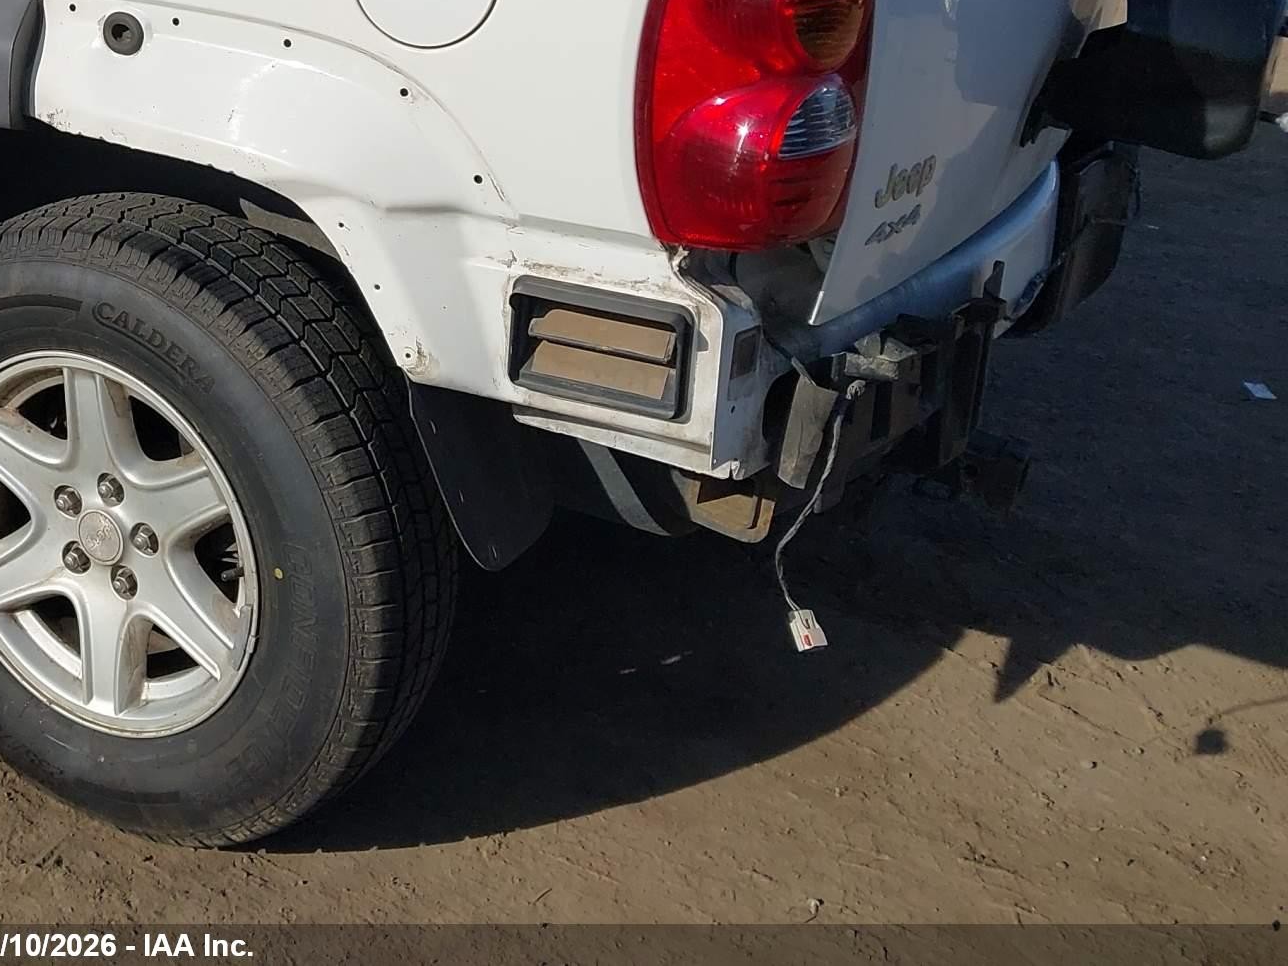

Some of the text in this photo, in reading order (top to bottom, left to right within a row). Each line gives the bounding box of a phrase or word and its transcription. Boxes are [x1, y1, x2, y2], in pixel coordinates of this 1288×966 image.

[874, 154, 937, 209] Jeep
[864, 203, 922, 247] 4x4
[95, 301, 215, 395] CALDERA
